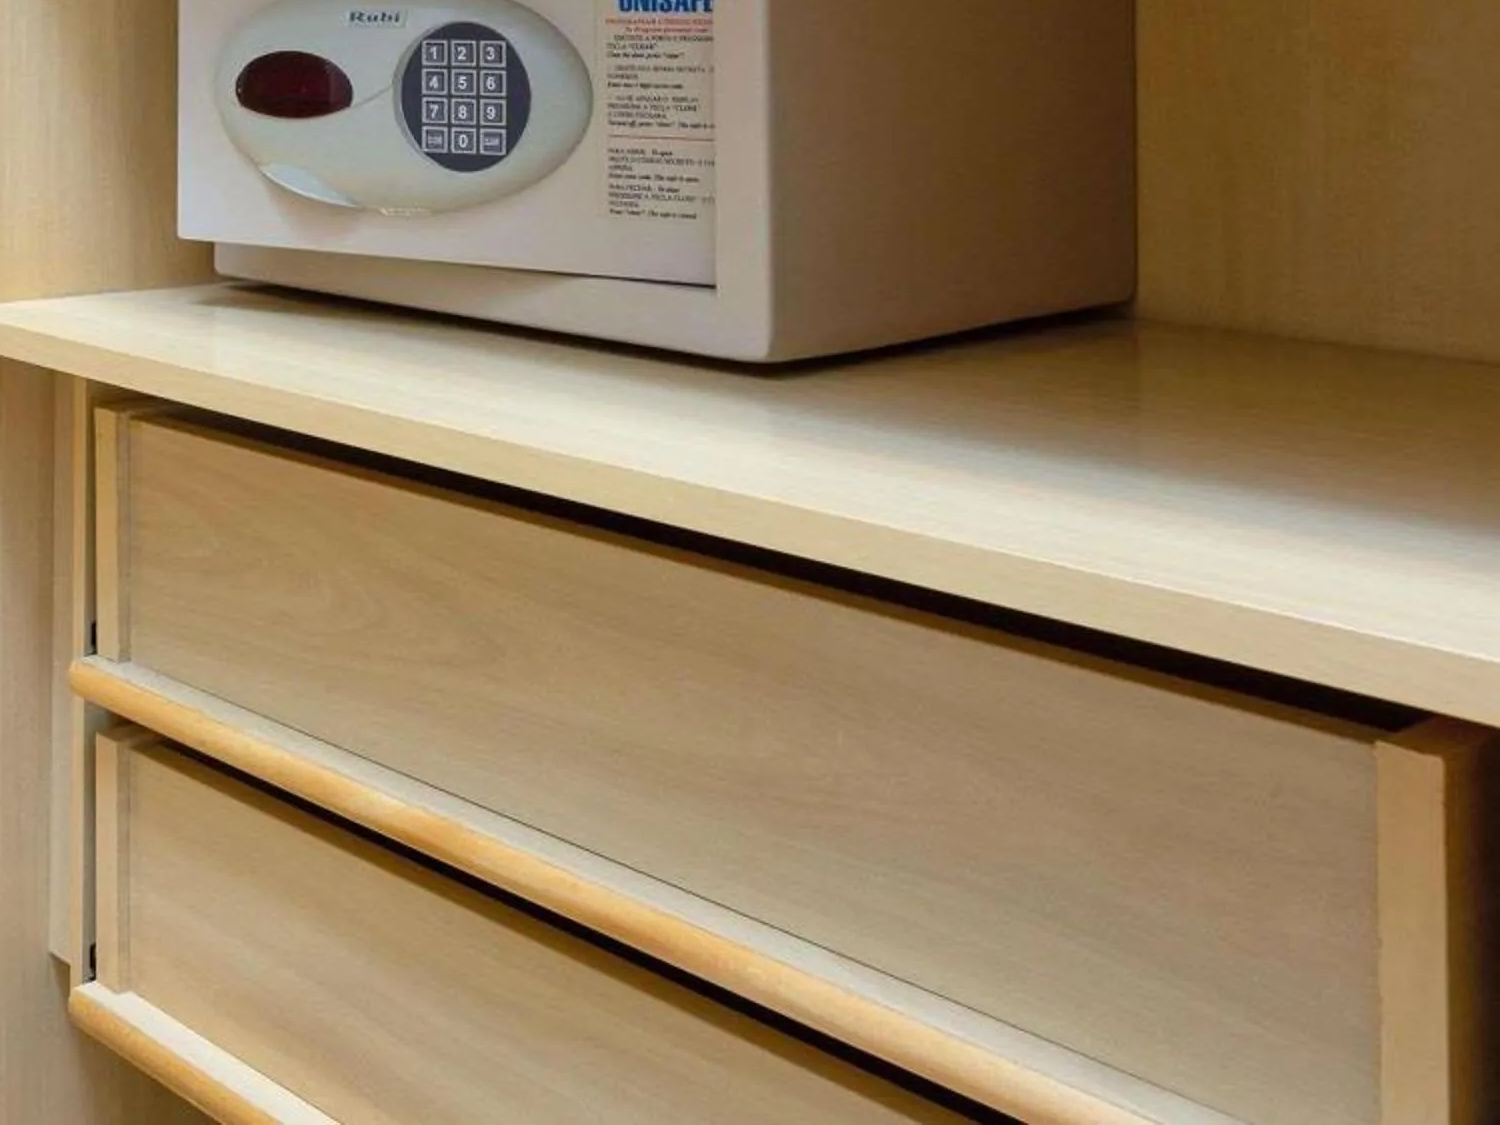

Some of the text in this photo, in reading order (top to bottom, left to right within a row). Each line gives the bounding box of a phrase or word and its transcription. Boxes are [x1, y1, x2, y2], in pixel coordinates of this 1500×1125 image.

[349, 10, 400, 24] Rubi
[429, 46, 496, 61] 1 2 3
[429, 76, 496, 91] 4 5 6
[429, 104, 496, 120] 7 8 9
[458, 133, 469, 149] 0
